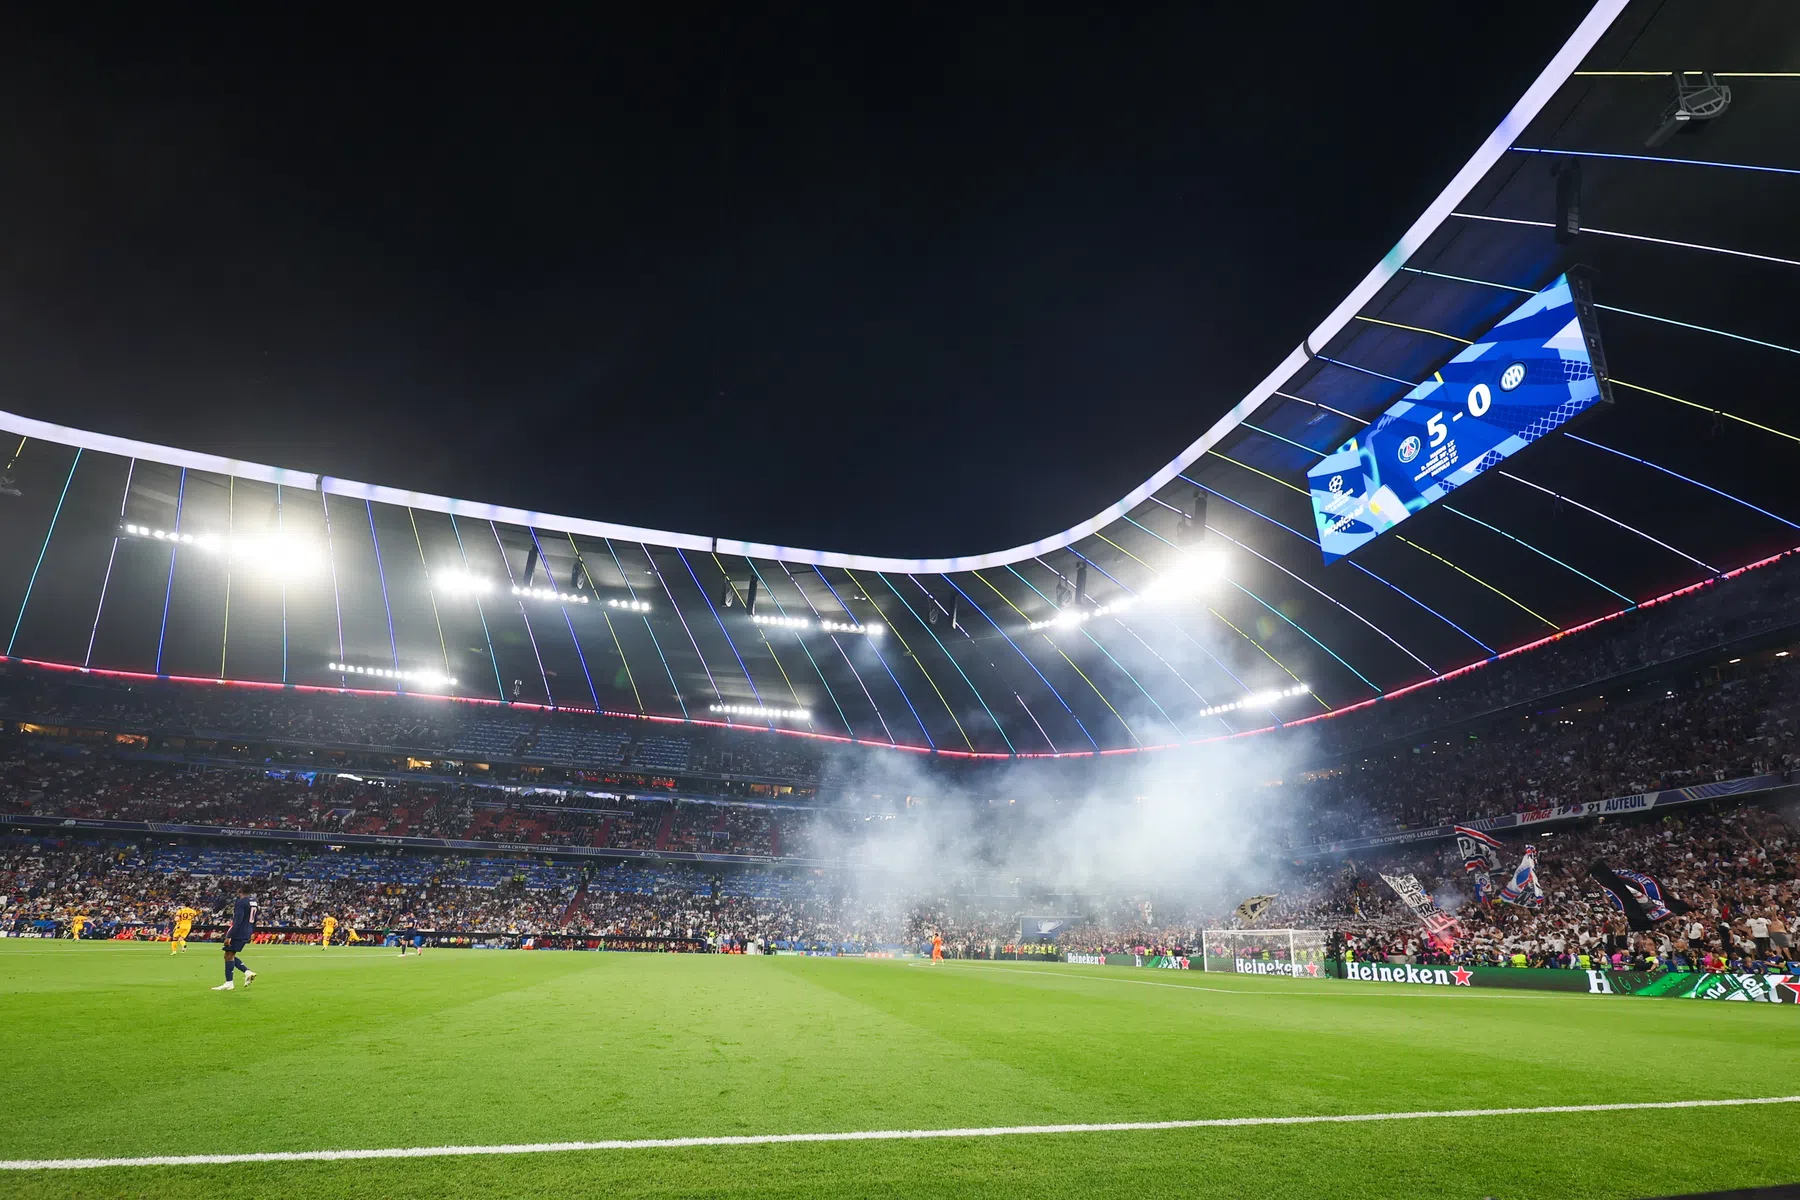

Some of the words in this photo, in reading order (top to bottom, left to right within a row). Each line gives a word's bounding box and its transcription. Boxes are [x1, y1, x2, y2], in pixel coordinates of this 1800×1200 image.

[1427, 411, 1448, 448] 5
[1468, 383, 1492, 418] 0
[1521, 808, 1553, 823] VIRAGE
[1604, 795, 1647, 812] AUTEUIL
[1384, 833, 1416, 843] CHAMPIONS
[1417, 829, 1440, 838] LEAGUE
[1067, 952, 1100, 965] Heineken
[1235, 958, 1303, 976] Heineken
[1346, 962, 1450, 985] Heineken
